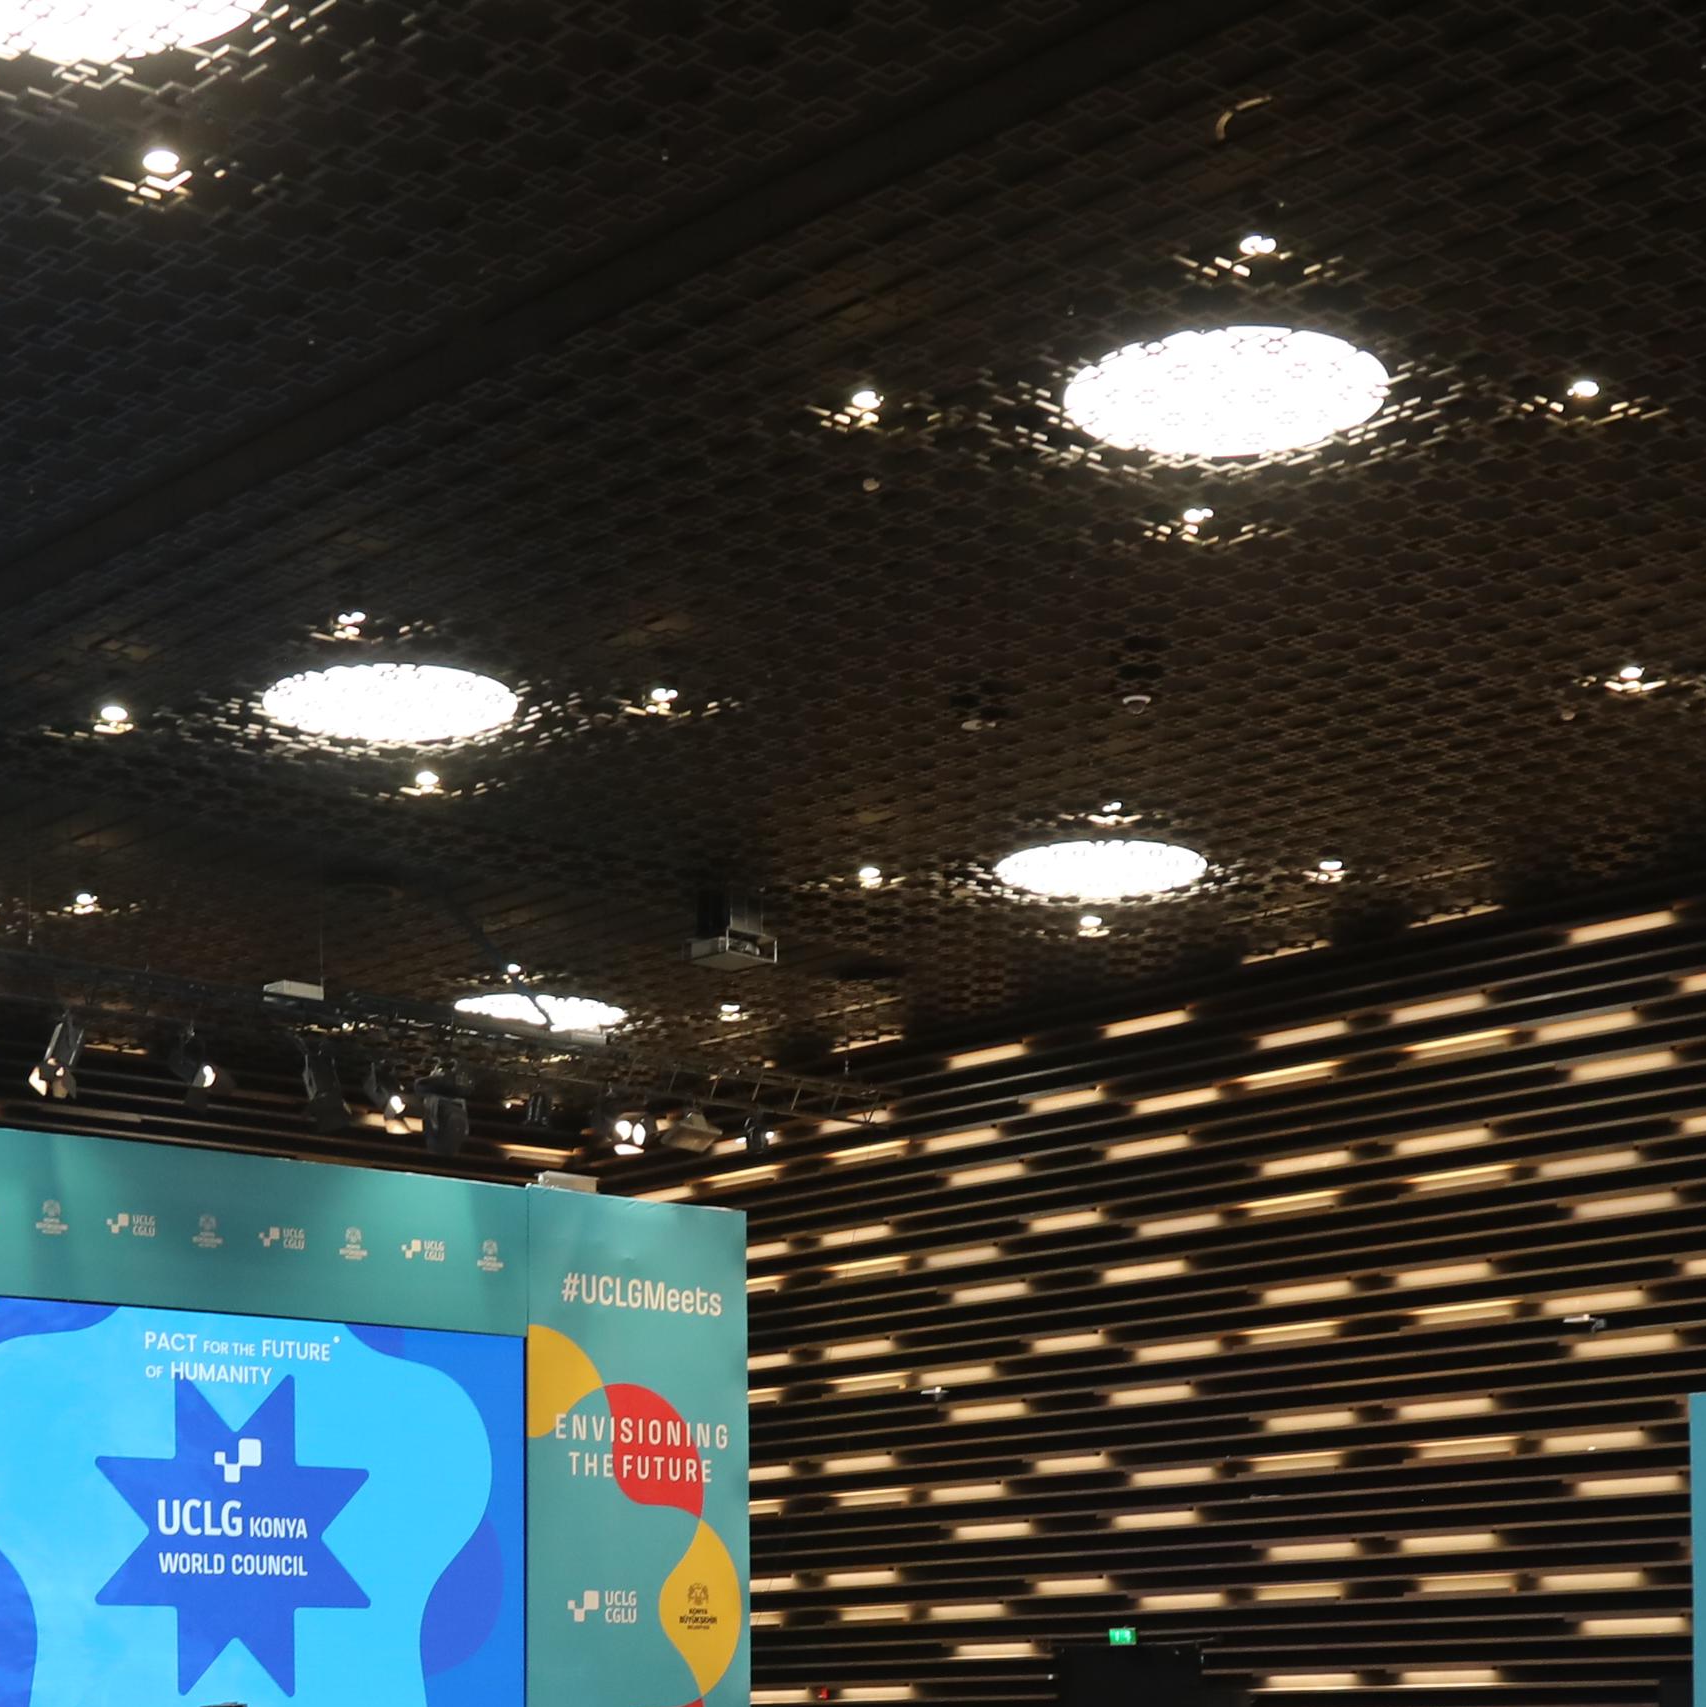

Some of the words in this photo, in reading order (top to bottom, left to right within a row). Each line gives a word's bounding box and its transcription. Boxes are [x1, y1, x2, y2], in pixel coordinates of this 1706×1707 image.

[562, 1272, 722, 1317] #UCLGMeets
[144, 1331, 198, 1353] PACT
[203, 1340, 229, 1355] FOR
[232, 1343, 255, 1357] THE
[262, 1339, 331, 1362] FUTURE
[146, 1365, 164, 1379] OF
[170, 1361, 273, 1385] HUMANITY
[555, 1413, 729, 1450] ENVISIONING
[569, 1451, 614, 1478] THE
[622, 1454, 712, 1483] FUTURE
[157, 1498, 243, 1537] UCLG
[249, 1516, 308, 1539] KONYA
[158, 1552, 225, 1575] WORLD
[231, 1554, 308, 1577] COUNCIL
[605, 1590, 637, 1606] UCLG
[605, 1607, 637, 1624] CGLU
